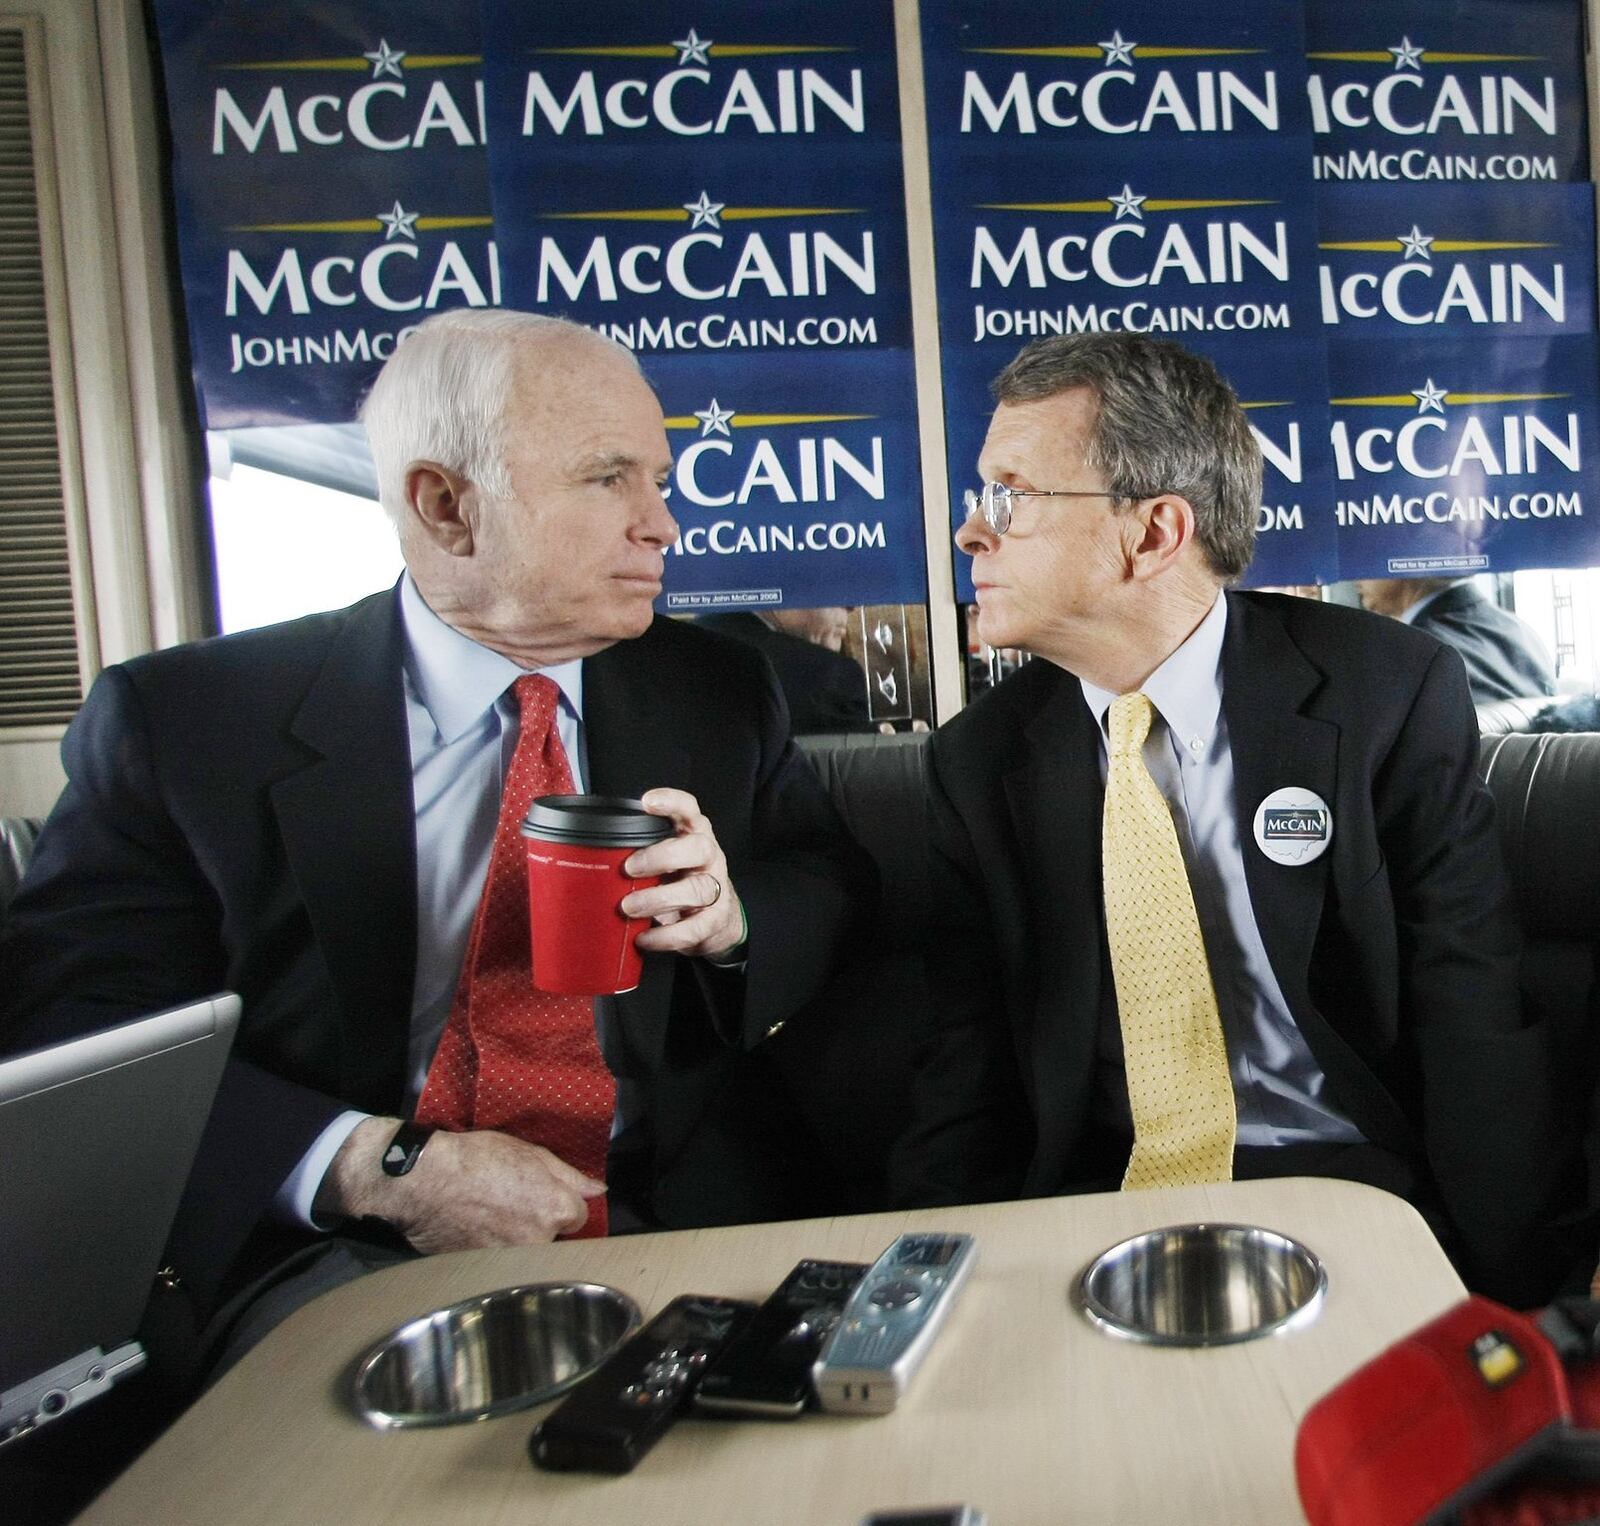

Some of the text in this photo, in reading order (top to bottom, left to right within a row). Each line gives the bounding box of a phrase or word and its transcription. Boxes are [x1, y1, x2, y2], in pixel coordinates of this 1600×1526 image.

[523, 69, 864, 135] McCAIN
[961, 71, 1278, 133] McCAIN
[537, 232, 875, 302] McCAIN
[971, 222, 1288, 287] McCAIN
[661, 436, 886, 508] CAIN
[672, 591, 779, 605] Paid for by John McCain 2008
[1267, 818, 1322, 831] McCAIN
